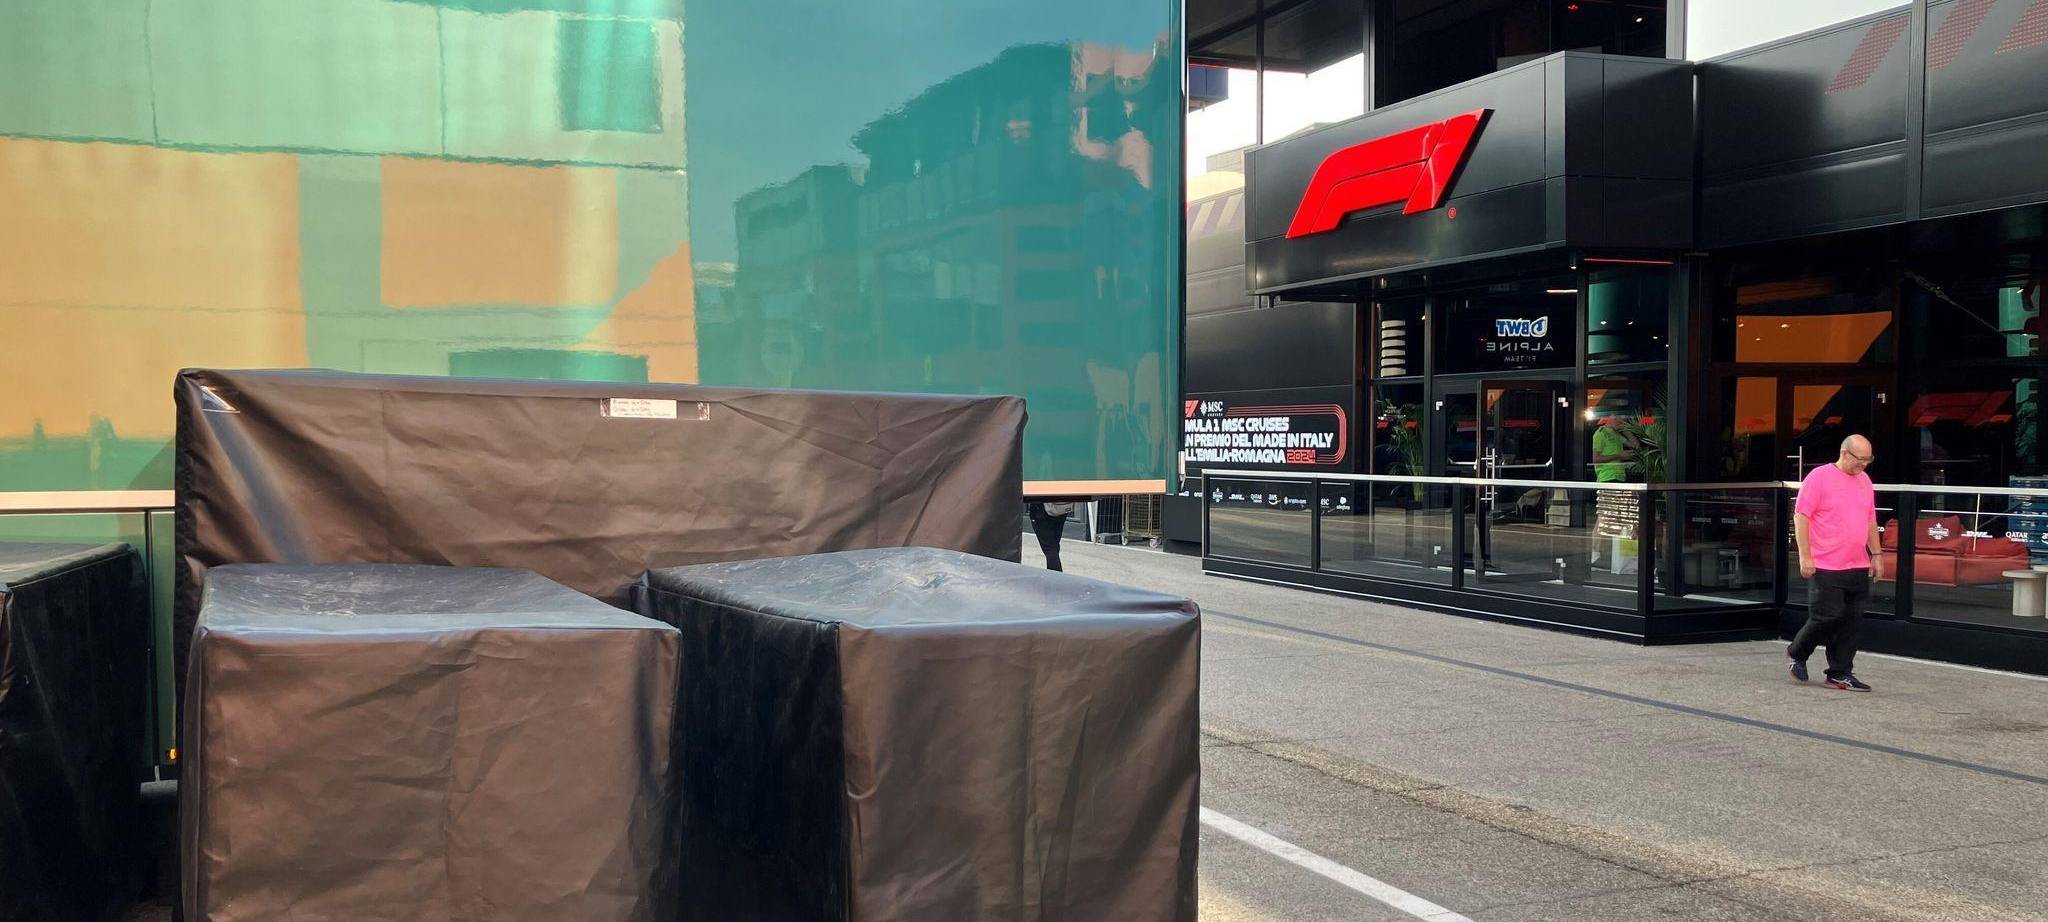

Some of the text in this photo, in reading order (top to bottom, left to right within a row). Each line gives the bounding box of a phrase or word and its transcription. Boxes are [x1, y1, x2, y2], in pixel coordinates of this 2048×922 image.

[1286, 108, 1487, 238] F1
[1207, 401, 1223, 412] MSC
[1213, 418, 1220, 432] 1
[1222, 417, 1245, 432] MSC
[1245, 416, 1290, 432] CRUISES
[1194, 433, 1231, 447] PREMIO
[1232, 433, 1251, 447] DEL
[1253, 433, 1286, 448] MADE
[1287, 433, 1299, 448] IN
[1300, 433, 1334, 448] ITALY
[1287, 449, 1316, 464] 2024
